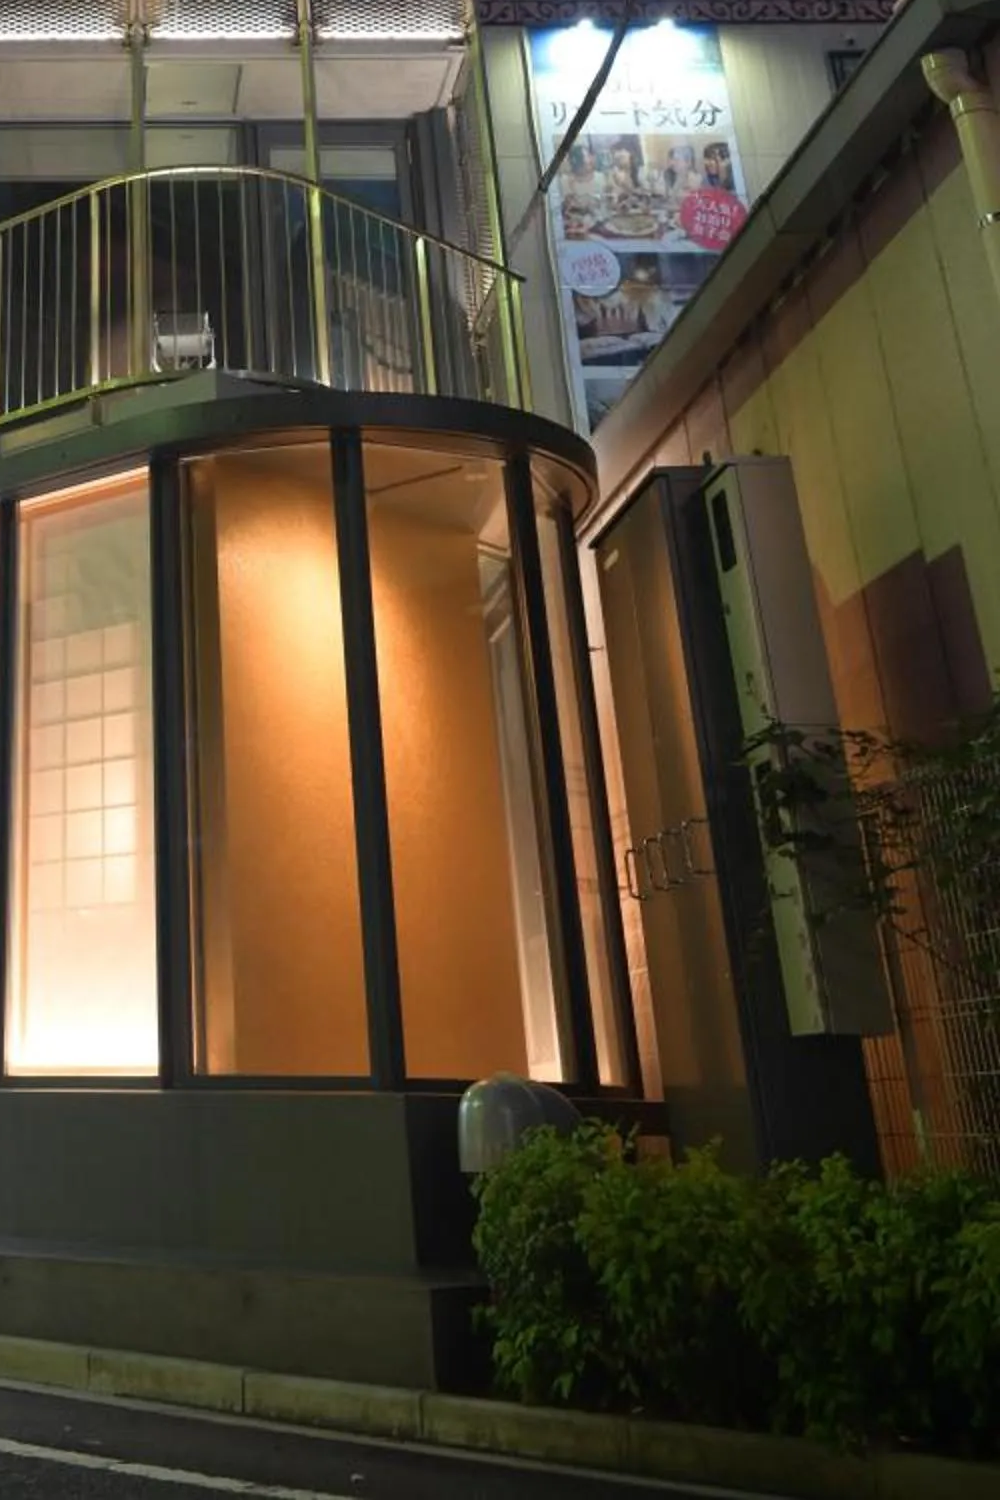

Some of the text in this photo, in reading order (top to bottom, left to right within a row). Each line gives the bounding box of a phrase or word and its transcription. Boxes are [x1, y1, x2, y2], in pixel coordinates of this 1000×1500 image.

[550, 98, 724, 128] リート気分
